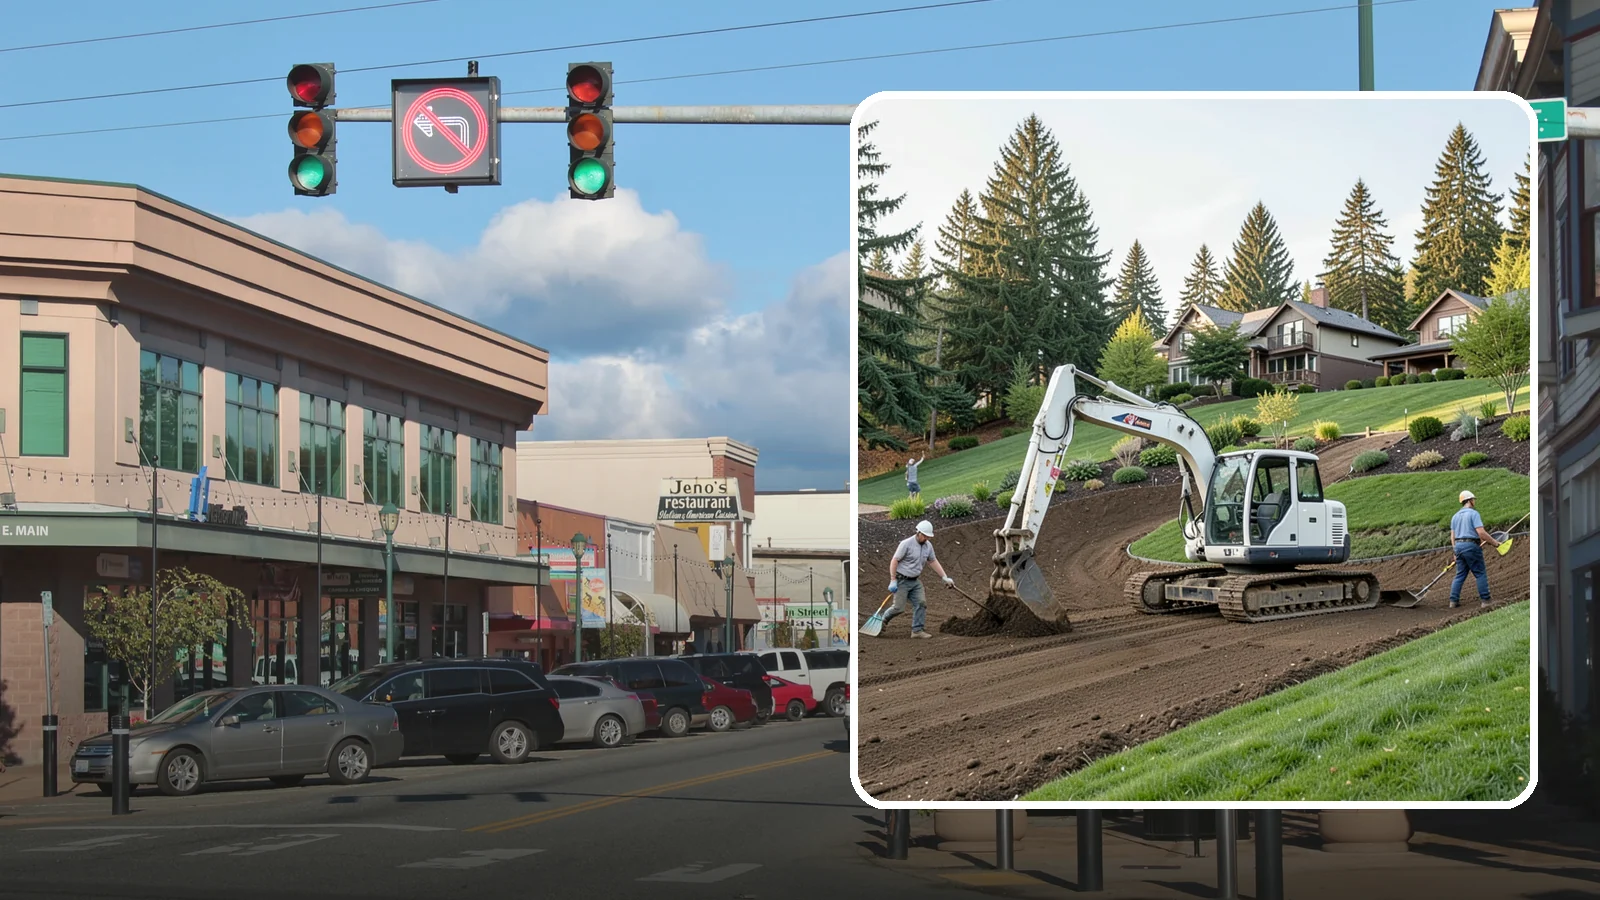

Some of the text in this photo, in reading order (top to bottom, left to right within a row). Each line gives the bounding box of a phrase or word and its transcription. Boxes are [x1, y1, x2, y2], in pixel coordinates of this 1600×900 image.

[669, 480, 727, 494] Jeno's
[665, 496, 731, 509] restaurant
[686, 510, 714, 519] American
[715, 510, 737, 519] Cuisine
[2, 525, 49, 536] E. MAIN
[797, 607, 829, 617] Street
[790, 619, 824, 627] lass
